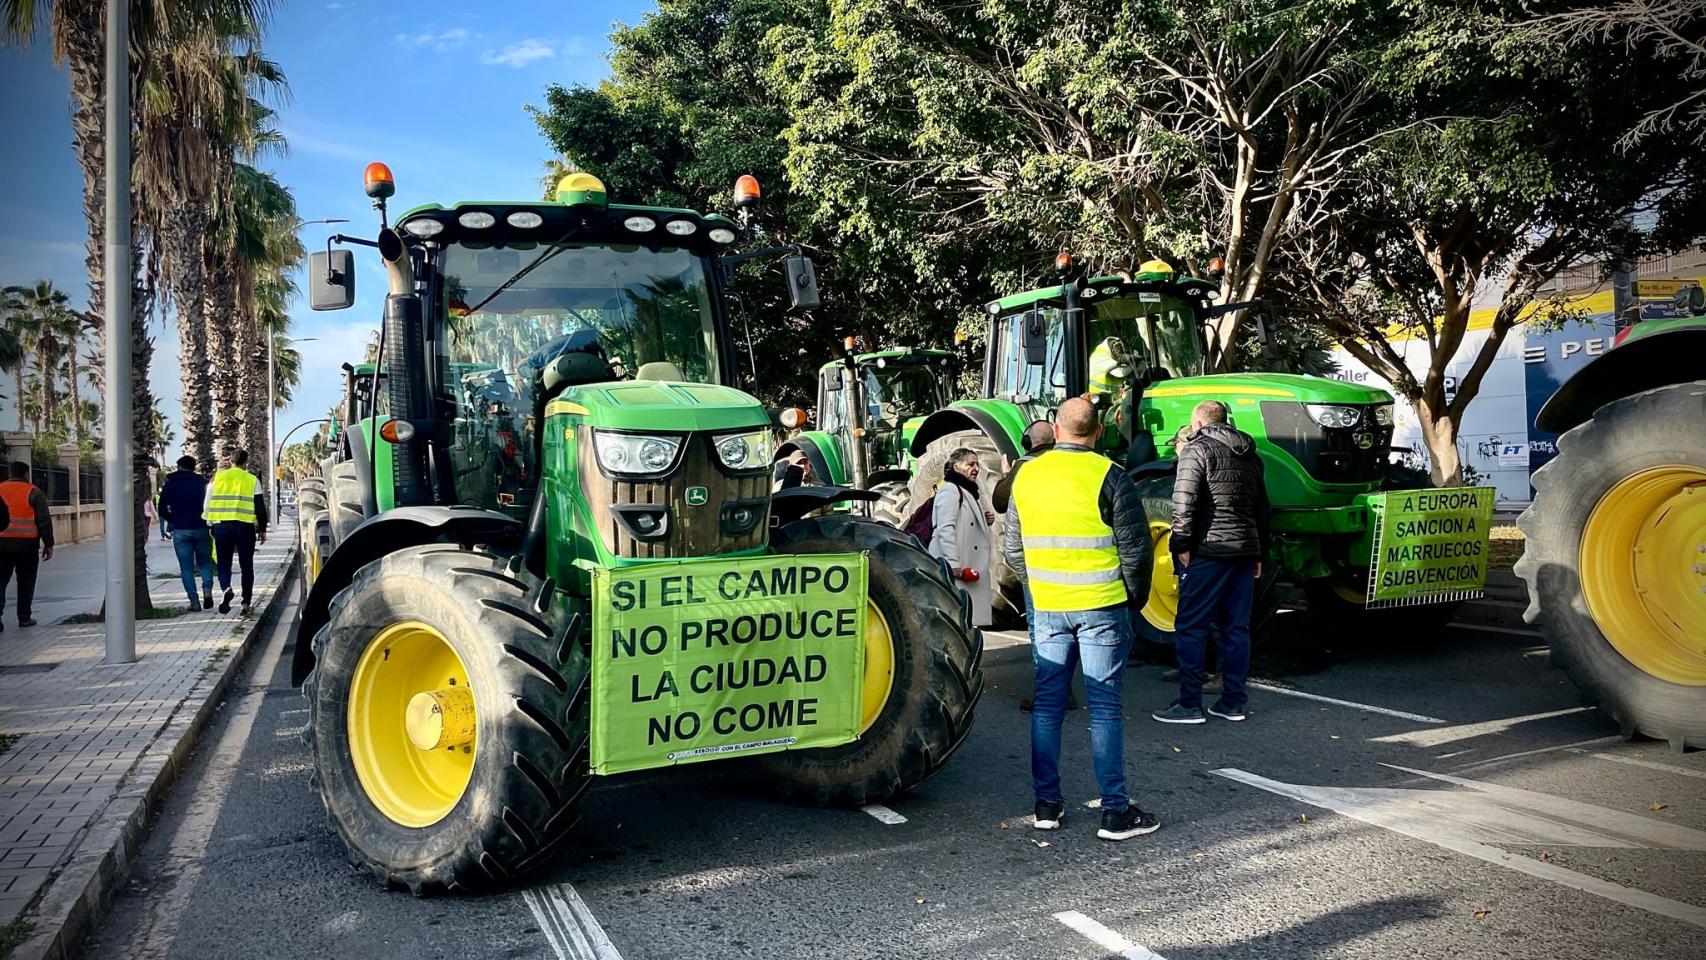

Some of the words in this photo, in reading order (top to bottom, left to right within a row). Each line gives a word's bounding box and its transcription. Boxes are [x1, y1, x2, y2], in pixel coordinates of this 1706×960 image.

[1403, 497, 1414, 512] A
[1418, 494, 1478, 511] EUROPA
[1396, 518, 1463, 537] SANCION
[1466, 518, 1476, 532] A
[1387, 541, 1482, 562] MARRUECOS
[612, 579, 646, 612] SI
[661, 575, 706, 607] EL
[718, 566, 850, 601] CAMPO
[1383, 562, 1479, 586] SUBVENCIÓN
[611, 625, 668, 659] NO
[681, 608, 857, 651] PRODUCE
[631, 670, 679, 703] LA
[690, 654, 827, 694] CIUDAD
[648, 711, 700, 746] NO
[712, 698, 818, 735] COME
